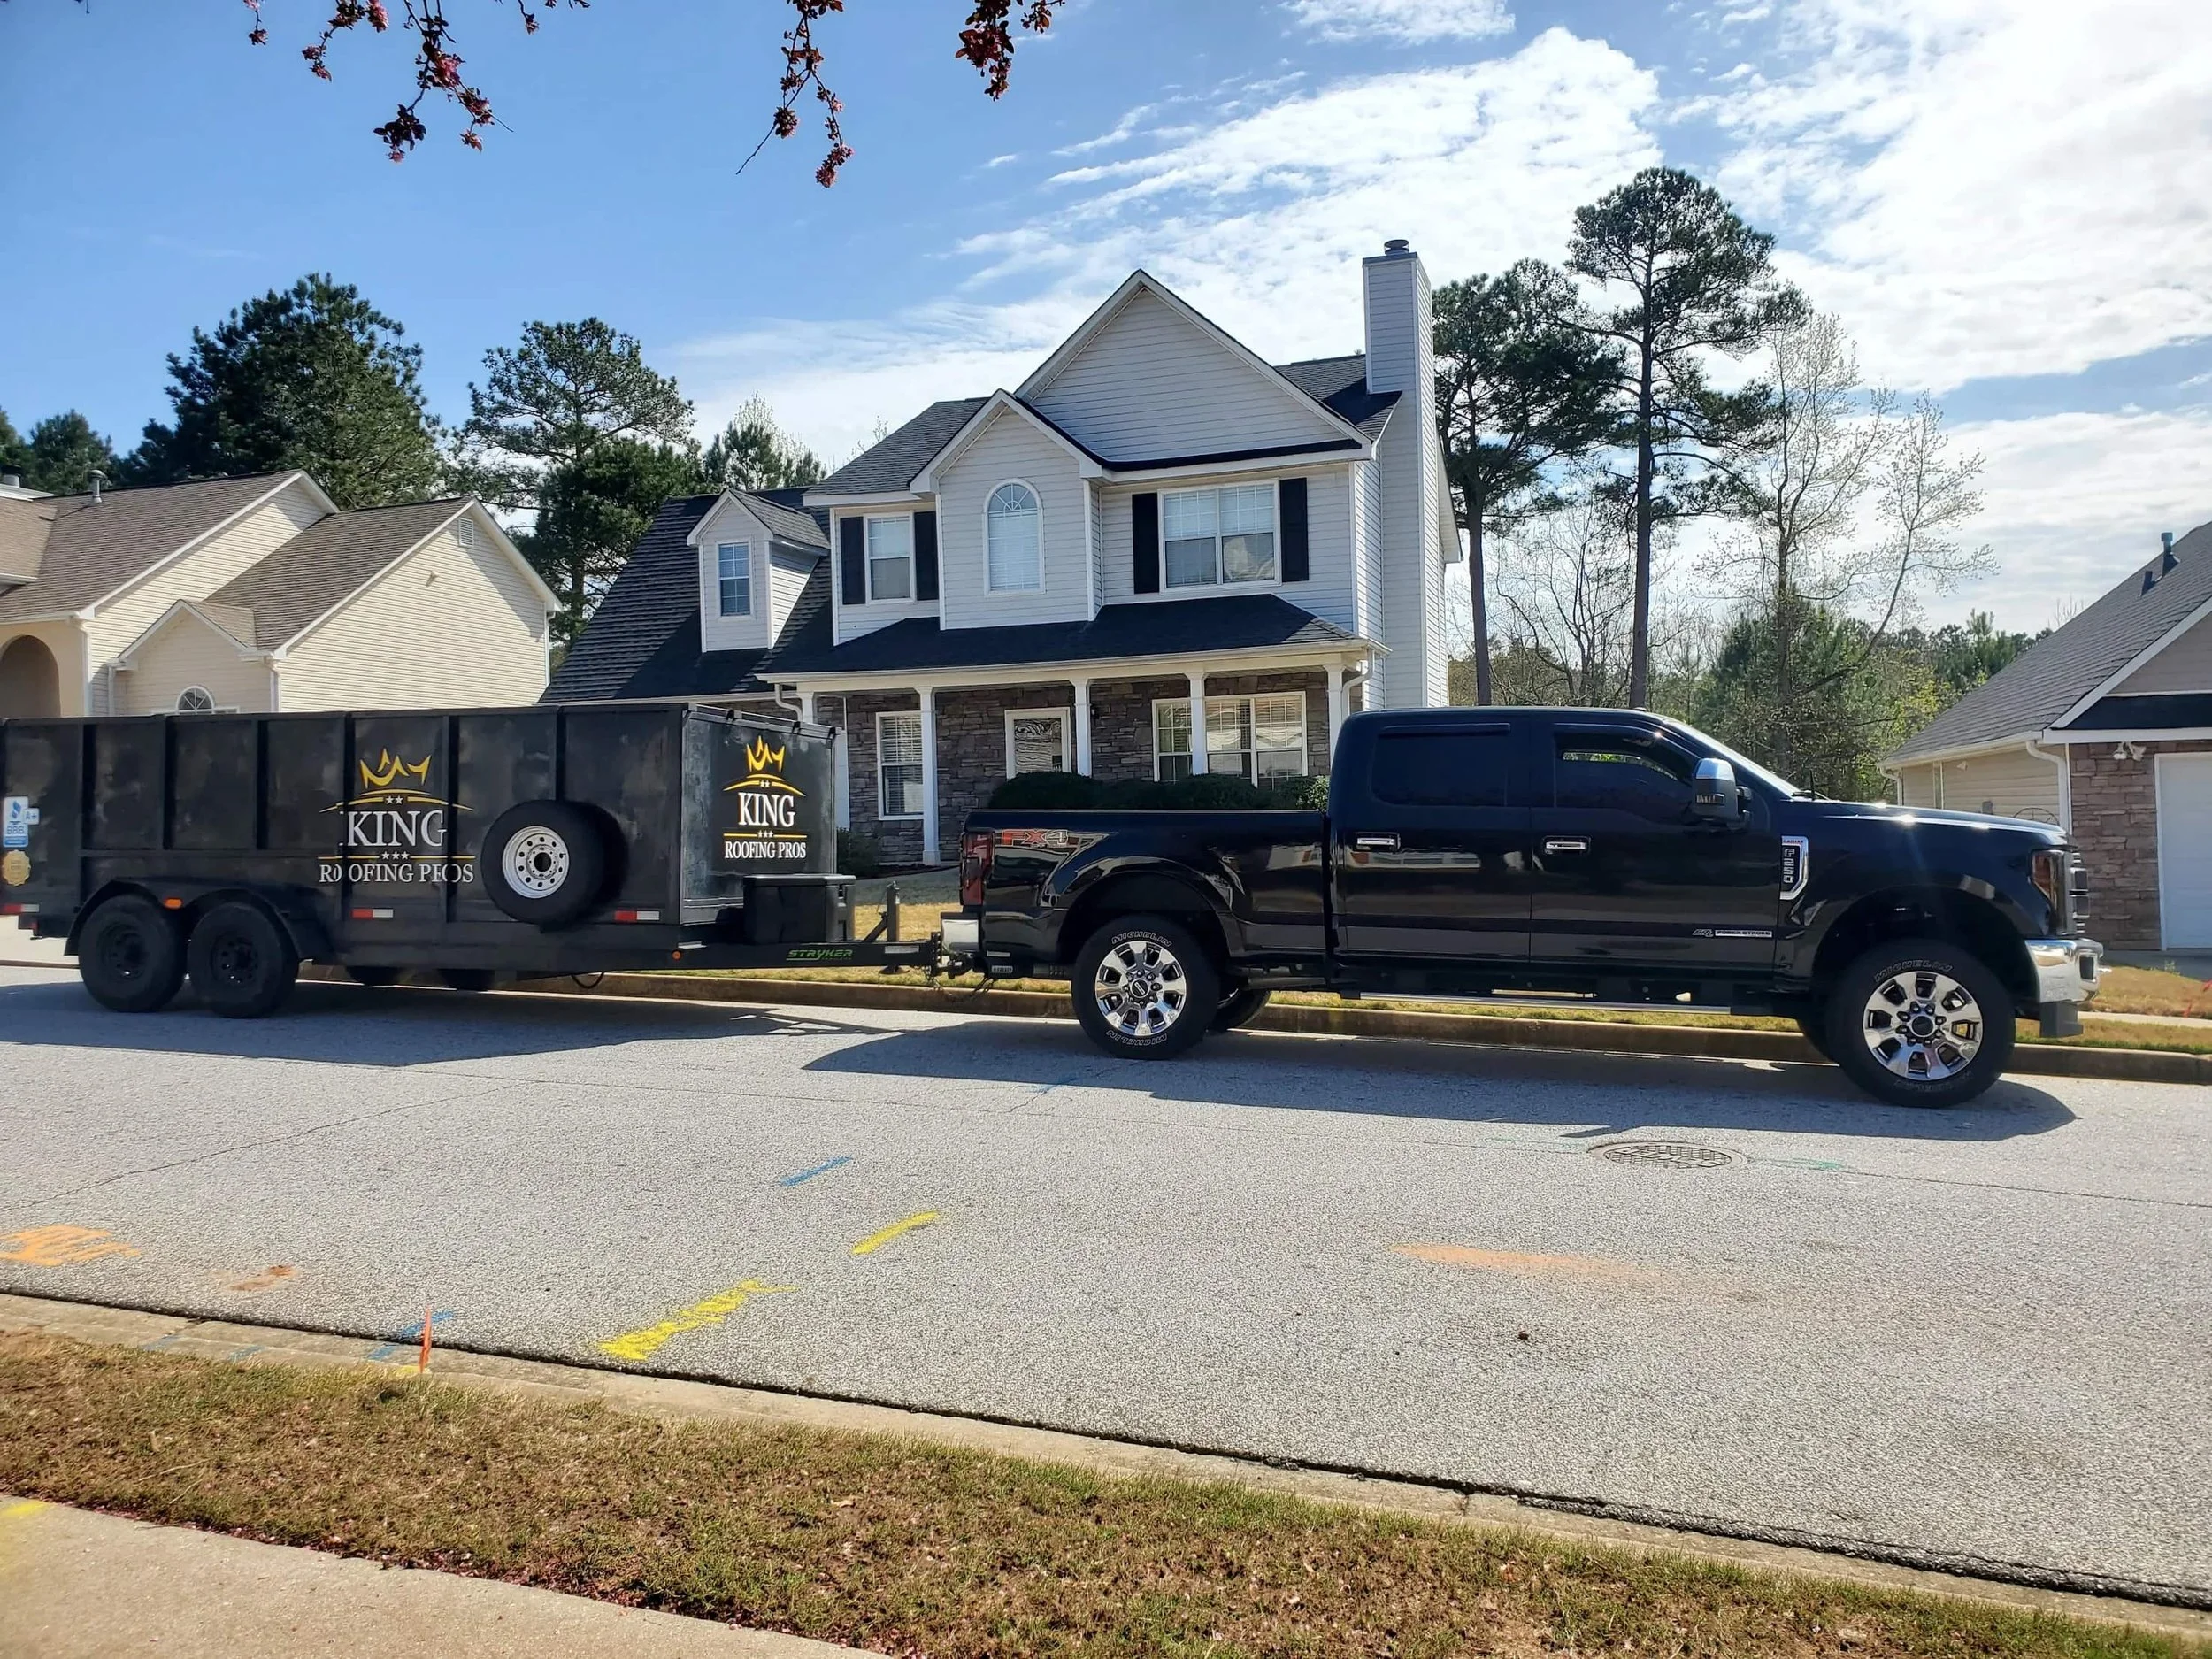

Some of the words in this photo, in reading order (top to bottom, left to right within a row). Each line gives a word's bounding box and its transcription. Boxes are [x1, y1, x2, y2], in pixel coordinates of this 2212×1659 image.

[738, 792, 795, 827] KING
[7, 826, 24, 834] BBB
[339, 810, 447, 847] KING
[1002, 829, 1068, 846] FX4
[725, 841, 776, 858] ROOFING
[778, 841, 807, 859] PROS
[319, 864, 414, 883] ROOFING
[1111, 931, 1172, 947] MICHELIN
[786, 949, 853, 960] STRYKER
[1873, 959, 1954, 982] MICHELIN
[1106, 1030, 1168, 1046] MICHELIN
